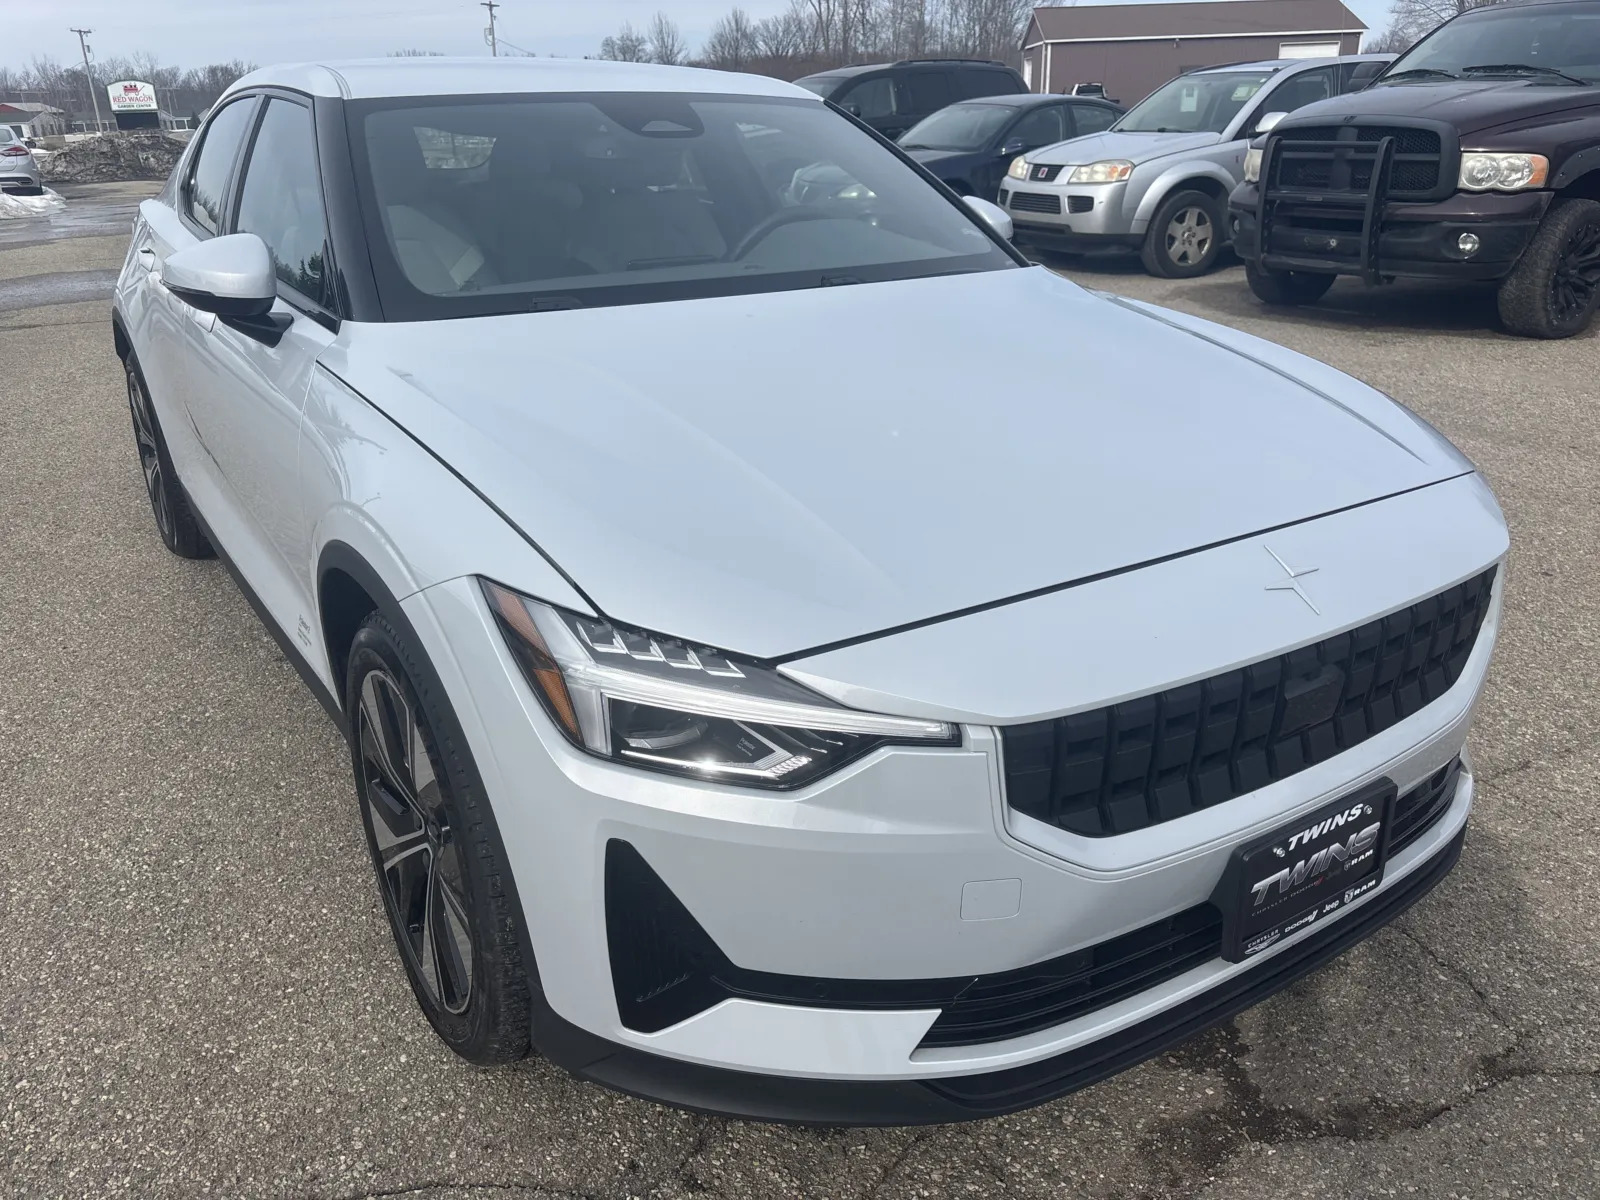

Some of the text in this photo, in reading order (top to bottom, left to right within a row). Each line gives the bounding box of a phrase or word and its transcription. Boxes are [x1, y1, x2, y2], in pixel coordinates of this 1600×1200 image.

[1288, 803, 1364, 851] TWINS
[1250, 821, 1381, 907] TWINS
[1351, 849, 1374, 866] RAM
[1247, 879, 1377, 948] CHRYSLER DODGE Jeep RAM
